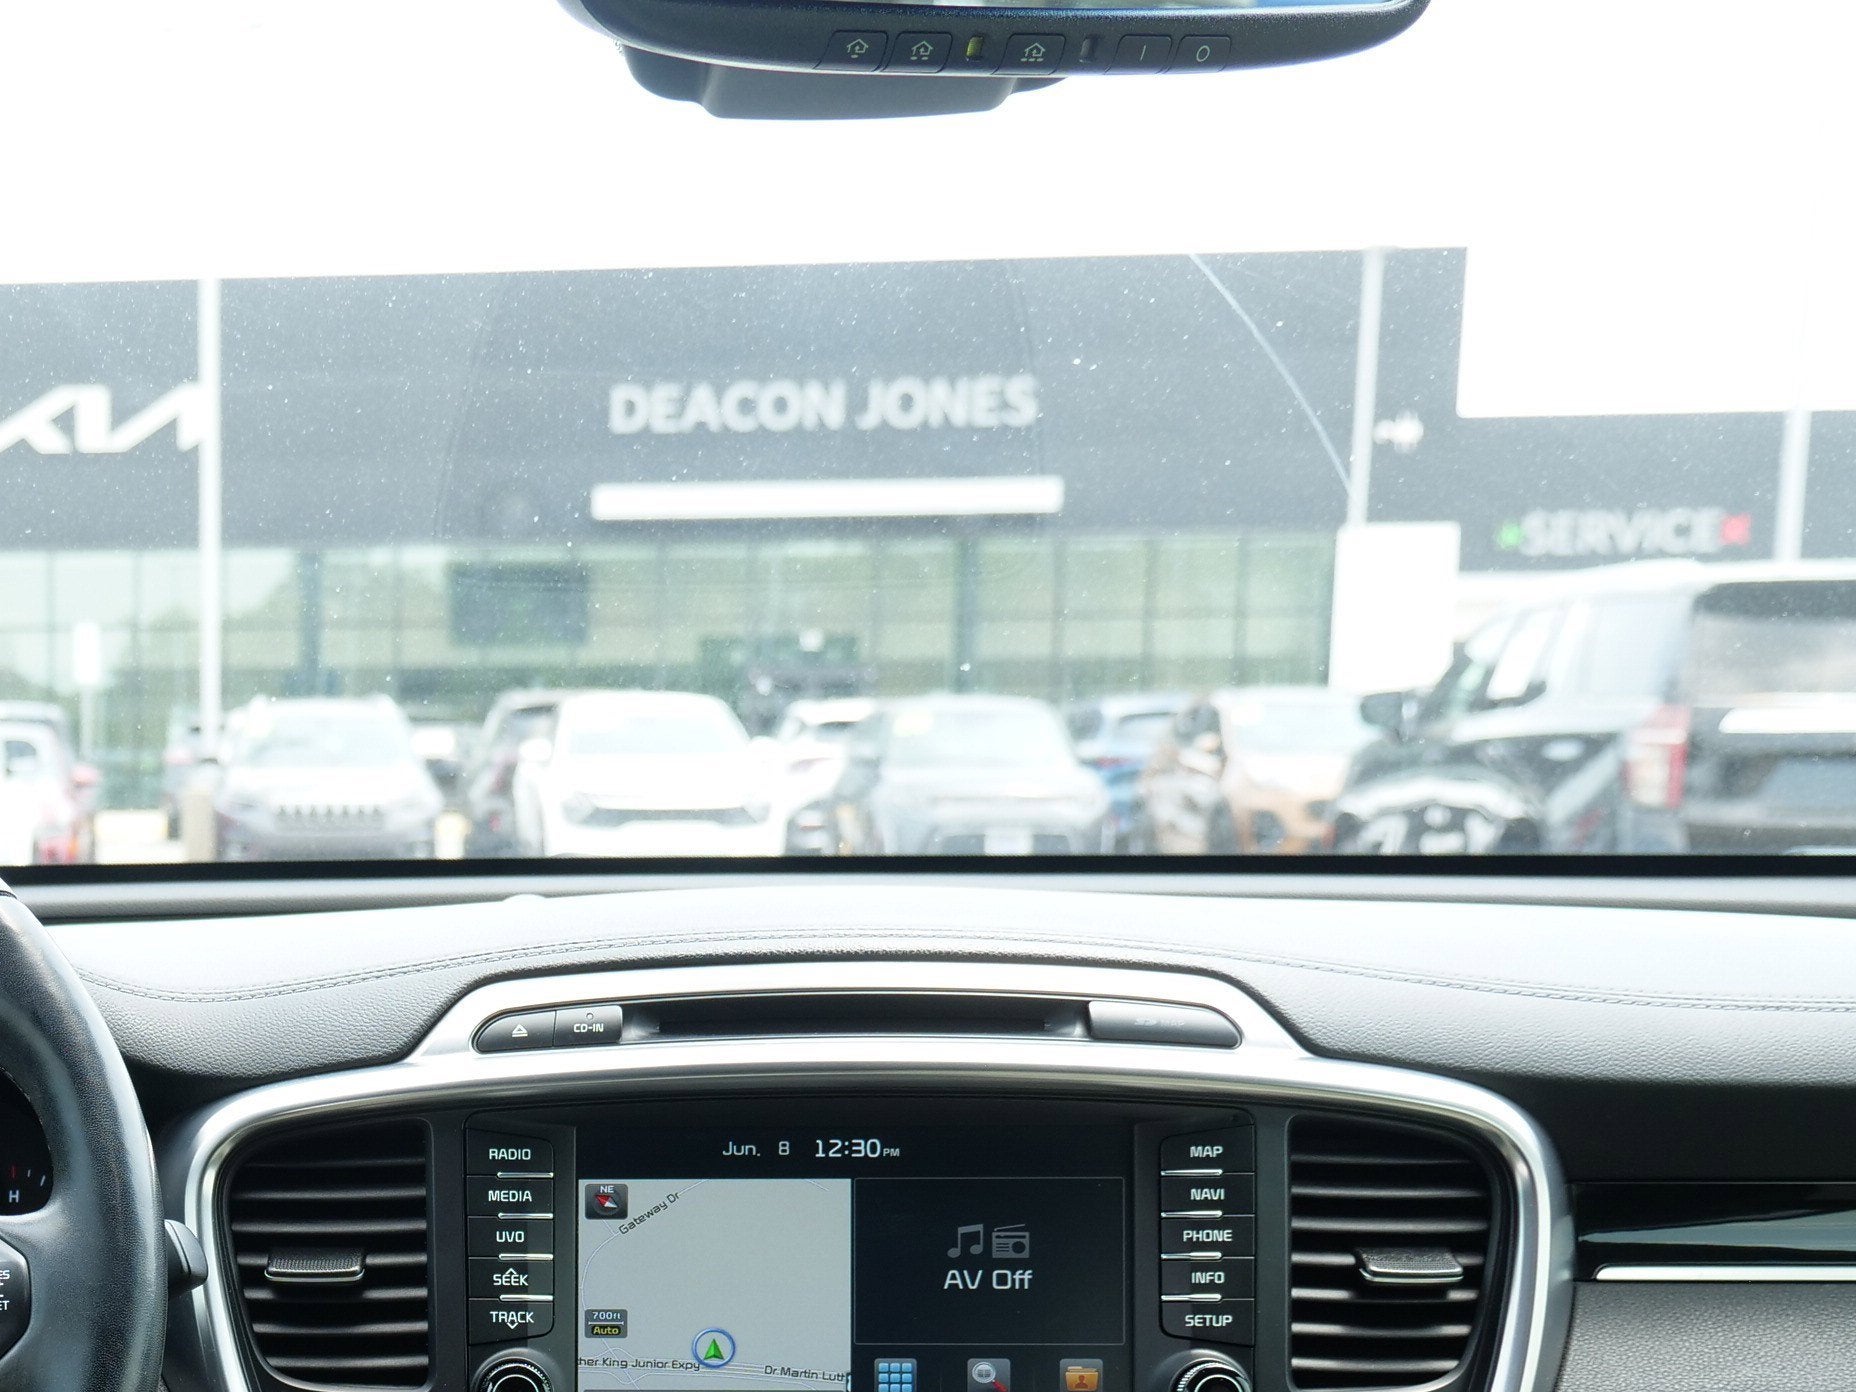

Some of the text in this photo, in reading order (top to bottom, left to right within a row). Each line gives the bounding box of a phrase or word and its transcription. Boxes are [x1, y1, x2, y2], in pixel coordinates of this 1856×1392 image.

[609, 374, 1038, 434] DEACON JONES
[1520, 507, 1723, 556] SERVICE
[573, 1023, 604, 1033] CD-IN
[722, 1138, 900, 1158] Jun. 8 12:30 PM
[1189, 1146, 1224, 1158] MAP
[488, 1148, 532, 1161] RADIO
[600, 1185, 615, 1193] NE
[1190, 1188, 1225, 1200] NAVI
[8, 1190, 19, 1203] H
[488, 1190, 533, 1203] MEDIA
[618, 1192, 680, 1235] Gateway Dr
[496, 1231, 525, 1243] UVO
[1183, 1230, 1233, 1242] PHONE
[492, 1274, 529, 1286] SEEK
[943, 1269, 1033, 1290] AV Off
[1191, 1272, 1225, 1284] INFO
[489, 1311, 534, 1324] TRACK
[592, 1311, 621, 1320] 700ft
[1185, 1315, 1233, 1327] SETUP
[593, 1325, 619, 1336] Auto
[602, 1357, 628, 1369] King
[631, 1359, 669, 1369] Junior
[671, 1360, 701, 1372] Expy
[764, 1365, 778, 1375] Dr
[780, 1366, 819, 1380] Martin
